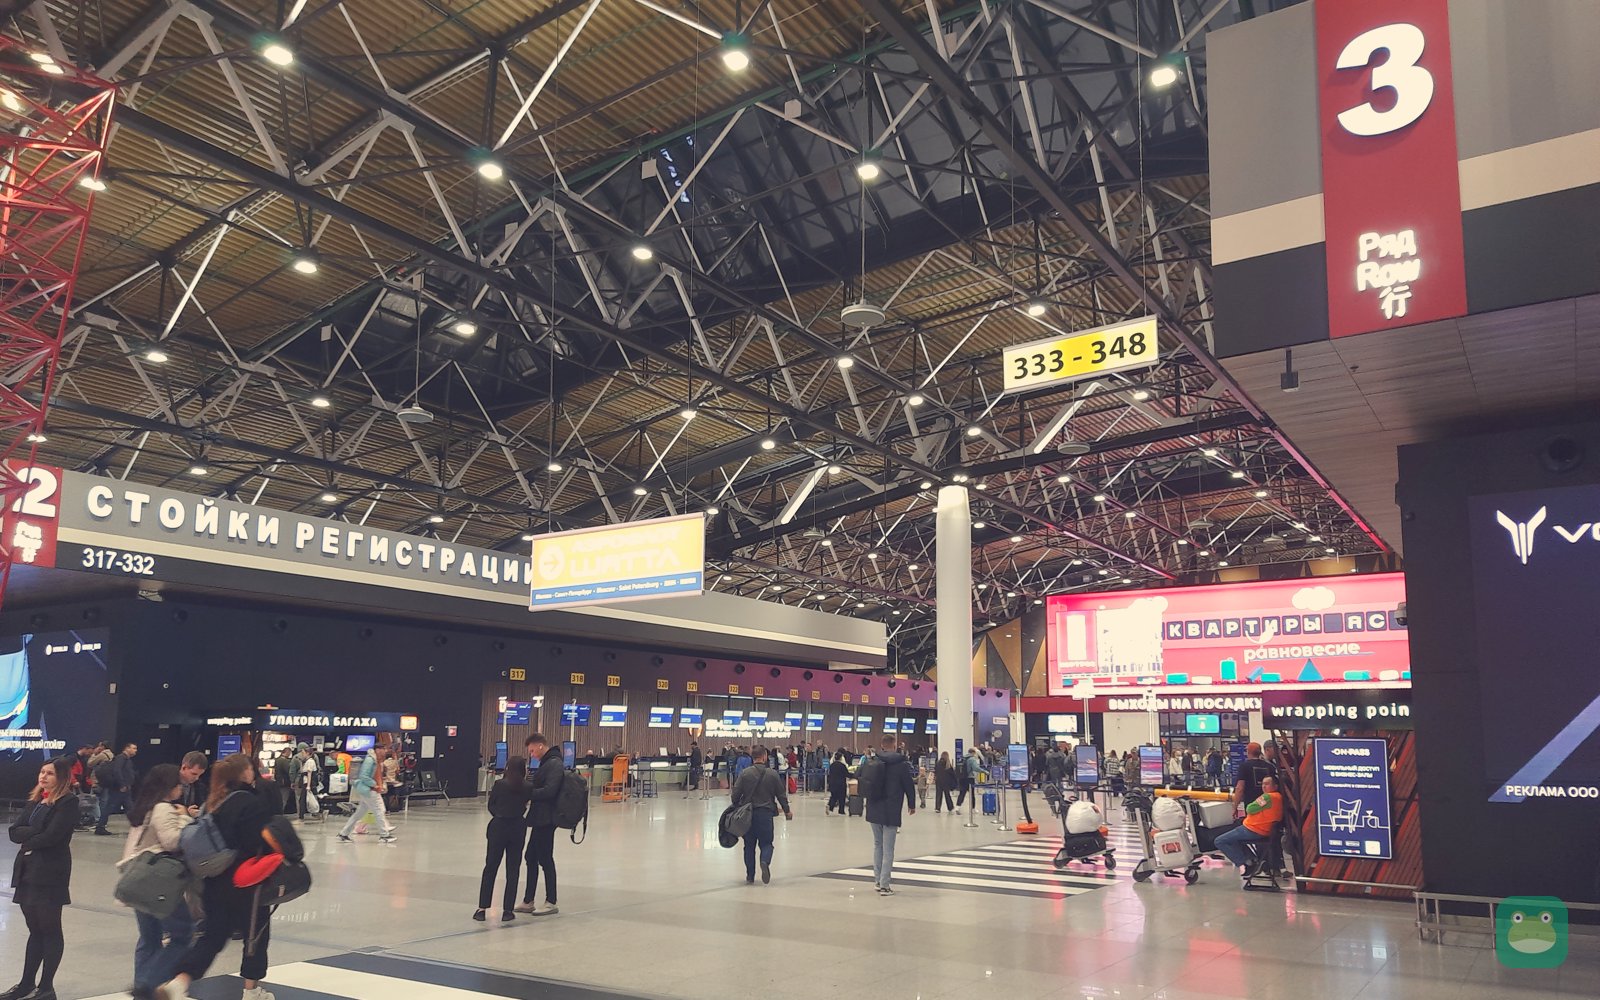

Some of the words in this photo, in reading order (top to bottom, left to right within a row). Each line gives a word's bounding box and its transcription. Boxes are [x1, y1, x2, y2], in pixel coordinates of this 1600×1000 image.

[1336, 23, 1434, 136] 3
[1356, 259, 1421, 292] Row
[1379, 285, 1412, 320] 行
[1014, 349, 1064, 379] 333
[1091, 333, 1146, 364] 348
[12, 467, 57, 518] 2
[87, 485, 279, 545] СТОЙКИ
[82, 548, 155, 575] 317-332
[1169, 617, 1321, 637] КВАРТИРЫ
[1243, 643, 1361, 664] равновесие
[511, 670, 525, 680] 317
[571, 673, 584, 683] 318
[608, 676, 620, 686] 319
[687, 682, 697, 691] 321
[1171, 698, 1191, 710] НА
[1271, 703, 1357, 719] wrapping
[269, 715, 330, 727] УПАКОВКА
[333, 716, 377, 727] БАГАЖА
[1506, 785, 1566, 797] РЕКЛАМА
[1568, 786, 1599, 798] ООО
